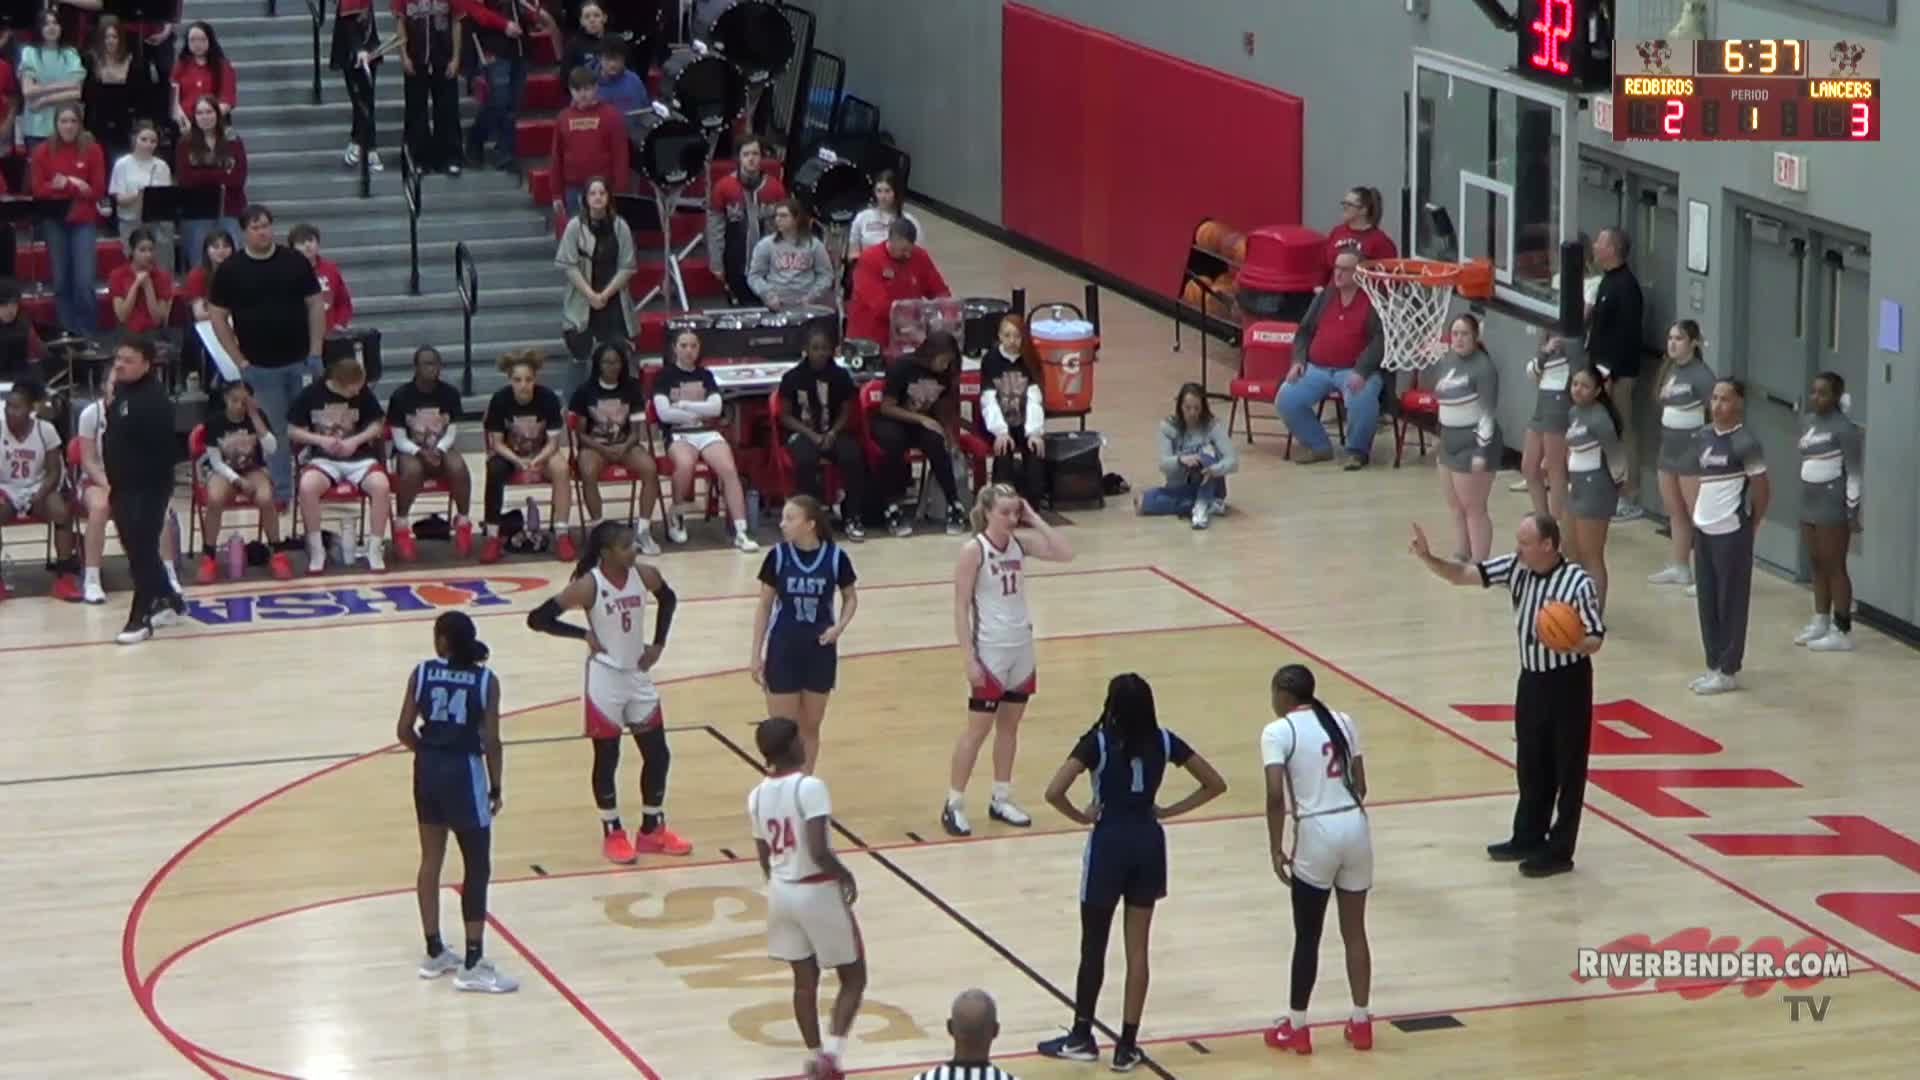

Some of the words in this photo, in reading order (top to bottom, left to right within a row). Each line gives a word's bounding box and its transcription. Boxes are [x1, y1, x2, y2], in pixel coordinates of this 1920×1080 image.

[787, 577, 827, 595] EAST
[1000, 573, 1017, 596] 11
[620, 611, 632, 634] 6
[793, 598, 818, 624] 15
[427, 667, 476, 685] LANCERS
[429, 687, 468, 725] 24
[1130, 757, 1144, 793] 1
[767, 818, 796, 854] 24
